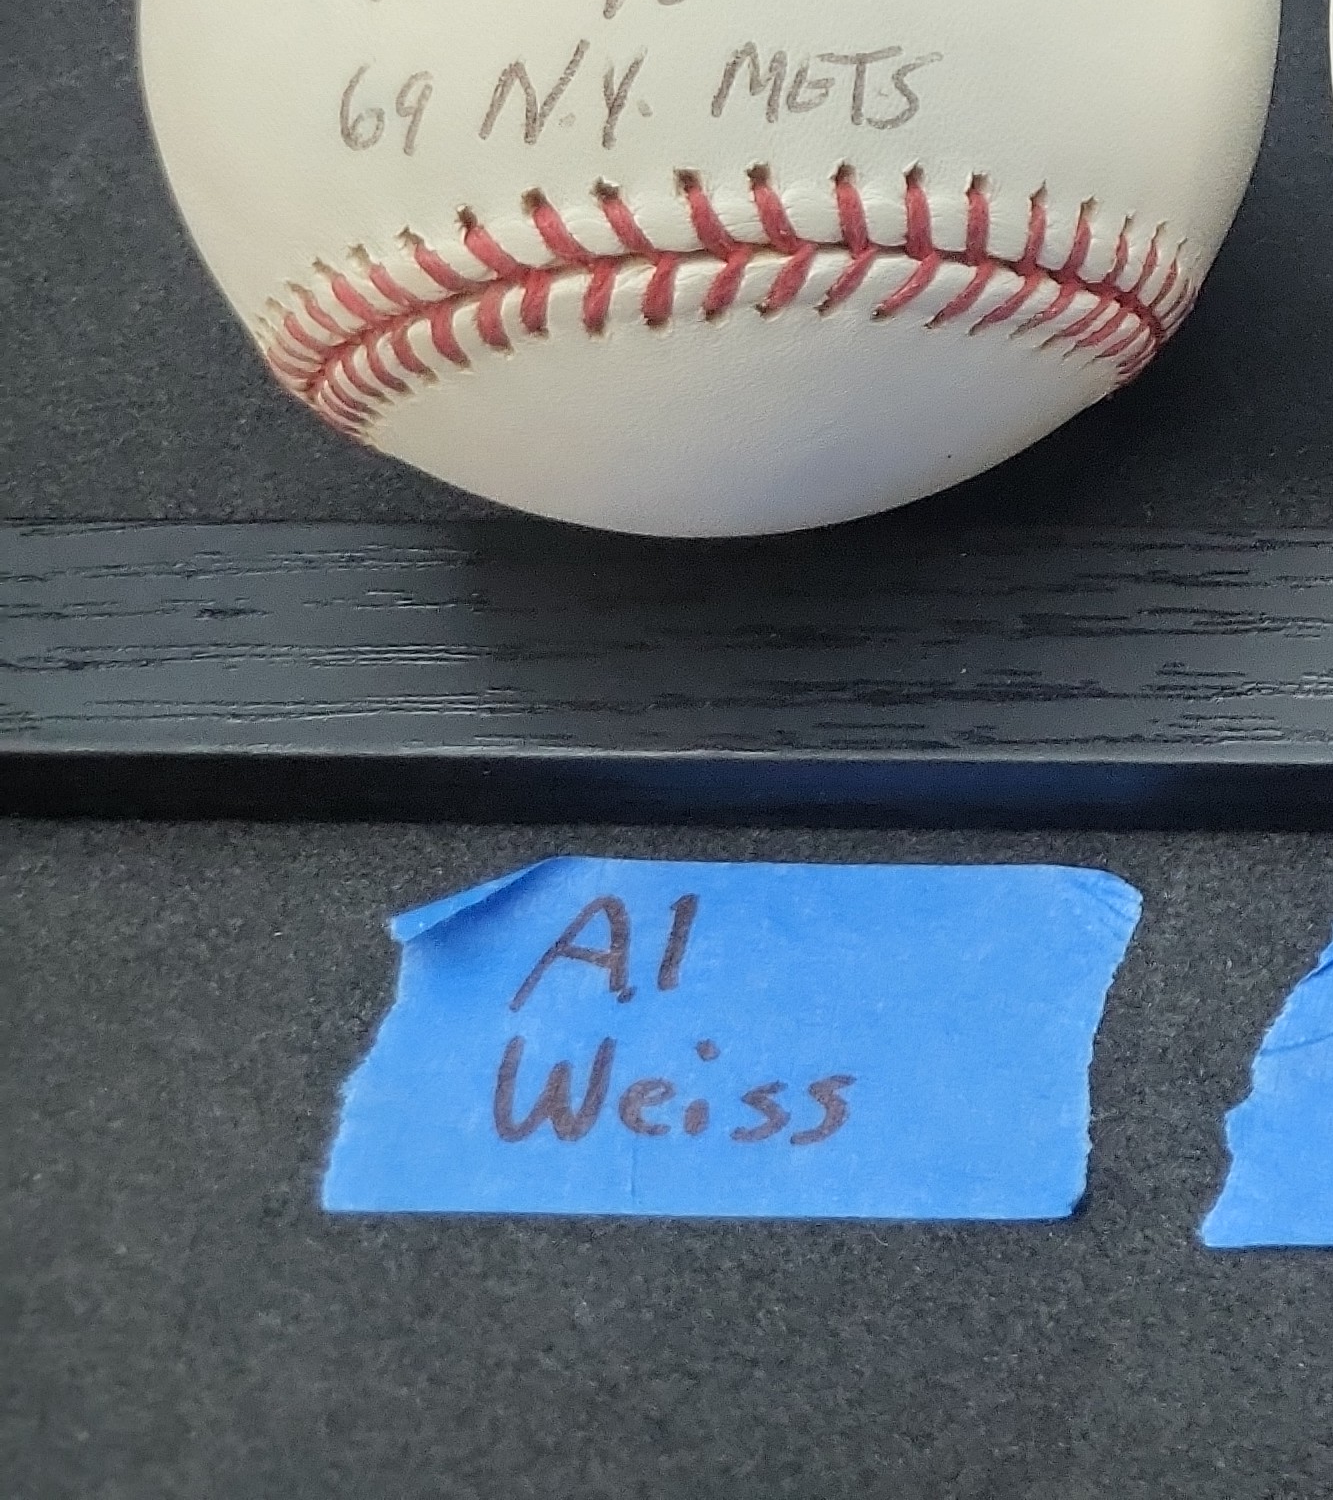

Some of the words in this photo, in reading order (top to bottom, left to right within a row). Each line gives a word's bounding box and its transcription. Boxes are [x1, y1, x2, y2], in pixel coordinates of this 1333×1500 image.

[478, 38, 653, 149] N.Y.
[711, 41, 945, 130] METS
[510, 891, 701, 1012] Al
[492, 1034, 858, 1146] Weiss
